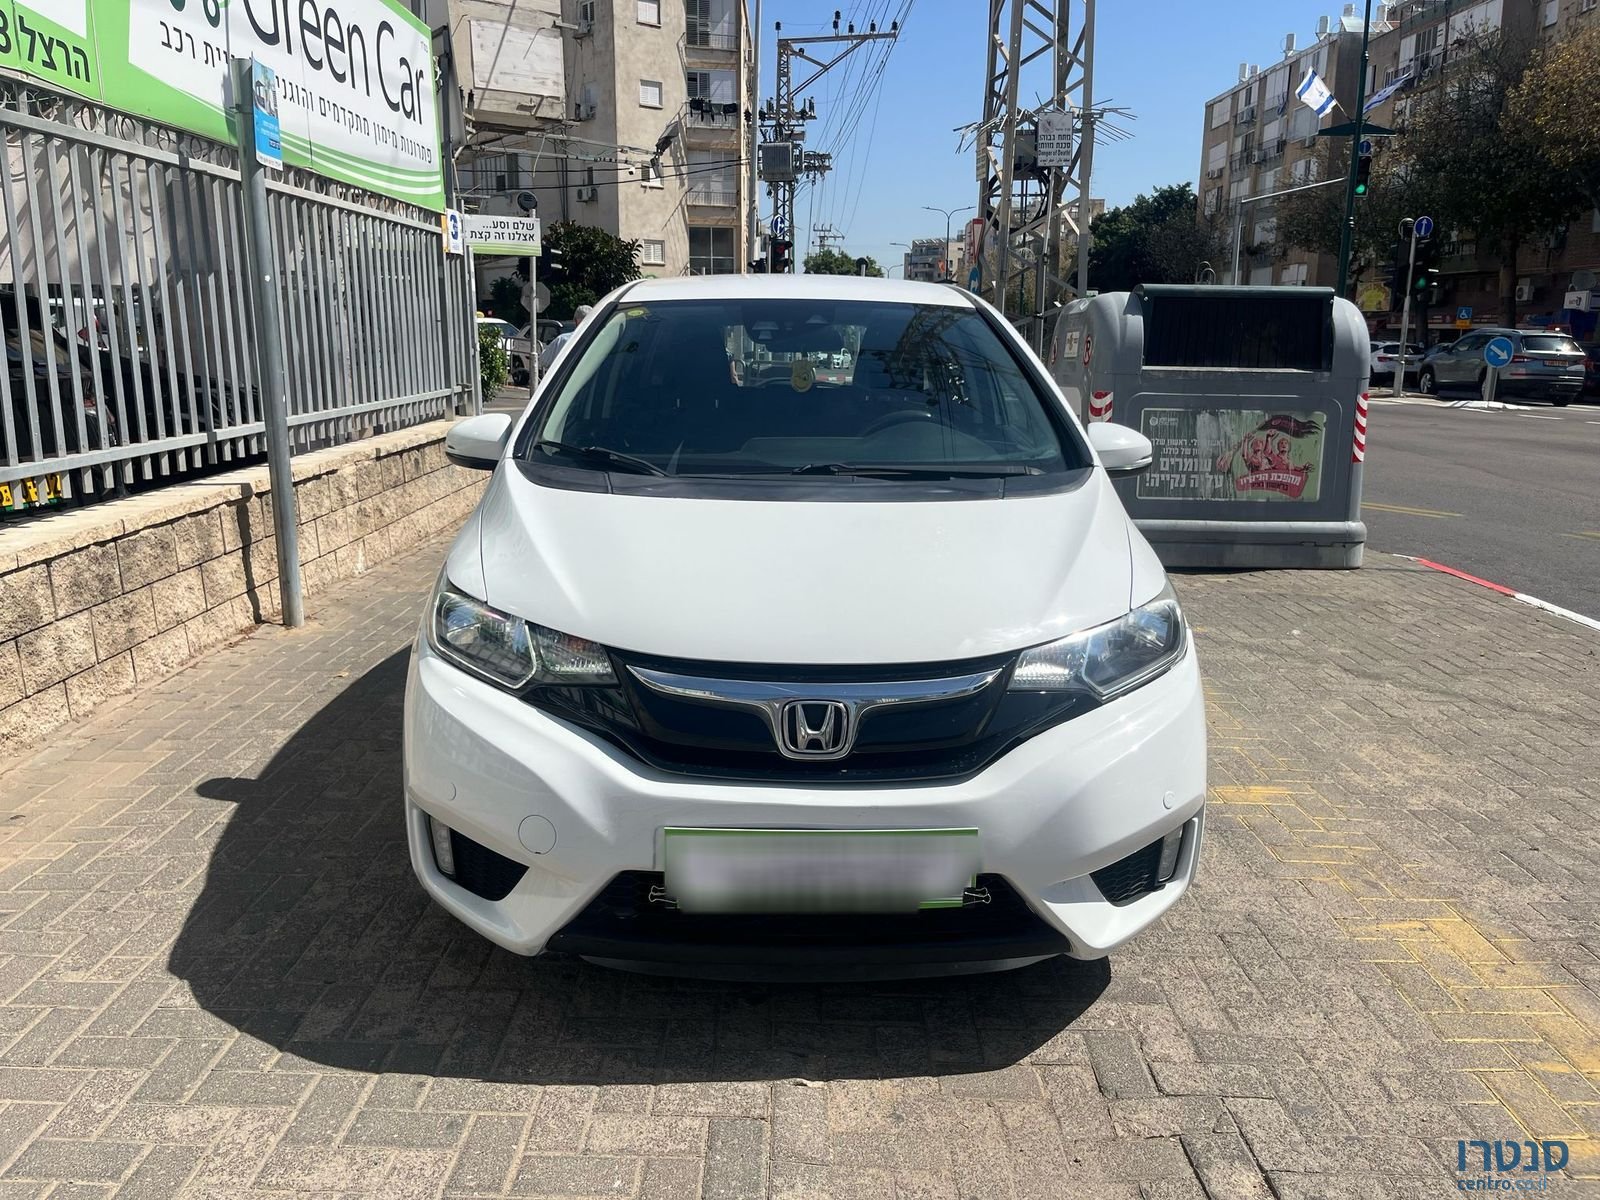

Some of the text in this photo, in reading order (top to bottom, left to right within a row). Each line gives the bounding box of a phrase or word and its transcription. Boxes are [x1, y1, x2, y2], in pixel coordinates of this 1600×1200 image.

[18, 14, 91, 83] הרצל
[159, 20, 196, 60] רכב
[376, 20, 424, 125] Car
[275, 75, 314, 111] והוגני
[319, 96, 370, 135] מתקדמים
[373, 121, 398, 148] מימון
[400, 135, 432, 164] פתרונות
[469, 230, 535, 242] אצלנו זה קצת
[482, 220, 535, 231] שלם וסע...
[1160, 457, 1212, 472] שומרים
[1145, 472, 1223, 489] עלה נקייה!
